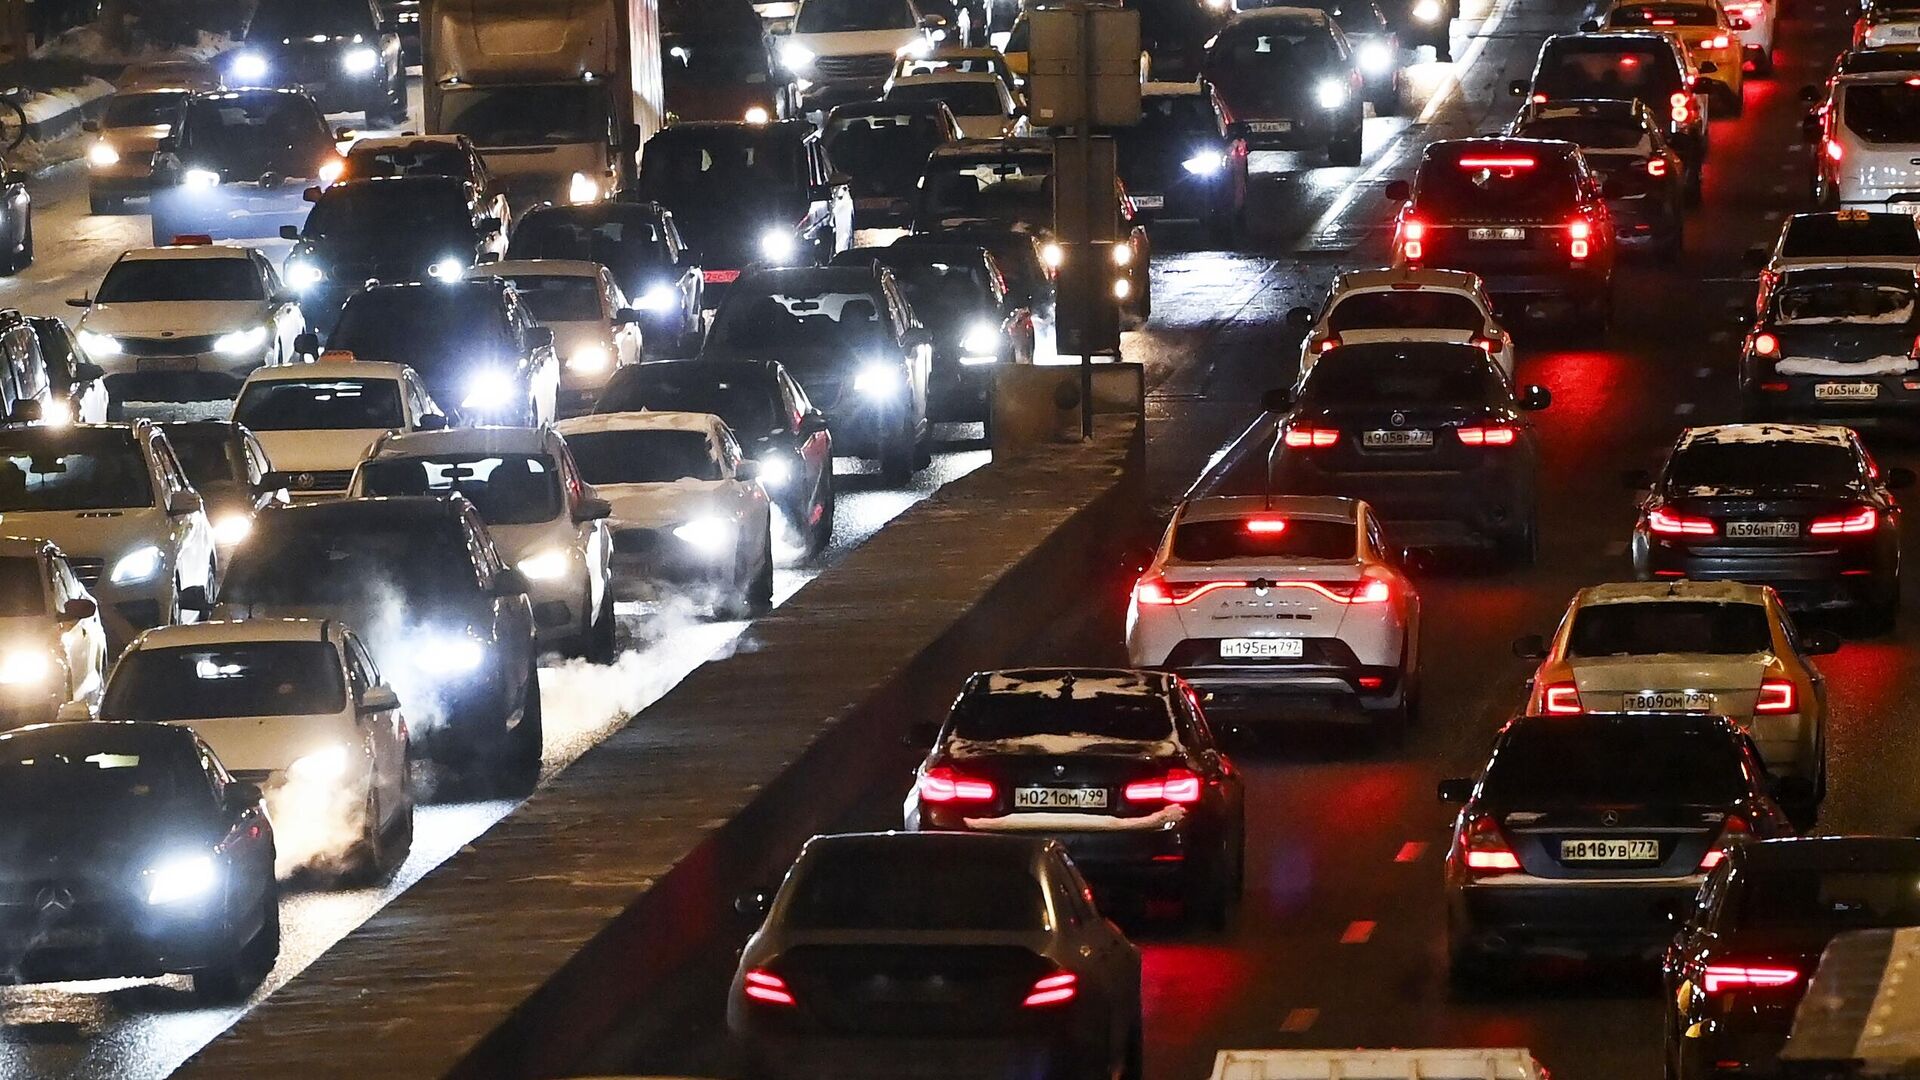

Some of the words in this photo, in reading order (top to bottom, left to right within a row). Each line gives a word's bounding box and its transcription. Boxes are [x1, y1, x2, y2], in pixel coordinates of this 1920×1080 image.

[1730, 523, 1775, 535] А596НТ
[1777, 523, 1796, 533] 799
[1225, 641, 1277, 654] Н195ЕМ
[1280, 641, 1299, 651] 797
[1629, 694, 1683, 708] Т809ОМ
[1684, 694, 1706, 704] 799
[1020, 790, 1078, 805] Н021ОМ
[1081, 790, 1104, 801] 799
[1566, 843, 1627, 858] Н818УВ
[1630, 842, 1654, 853] 777
